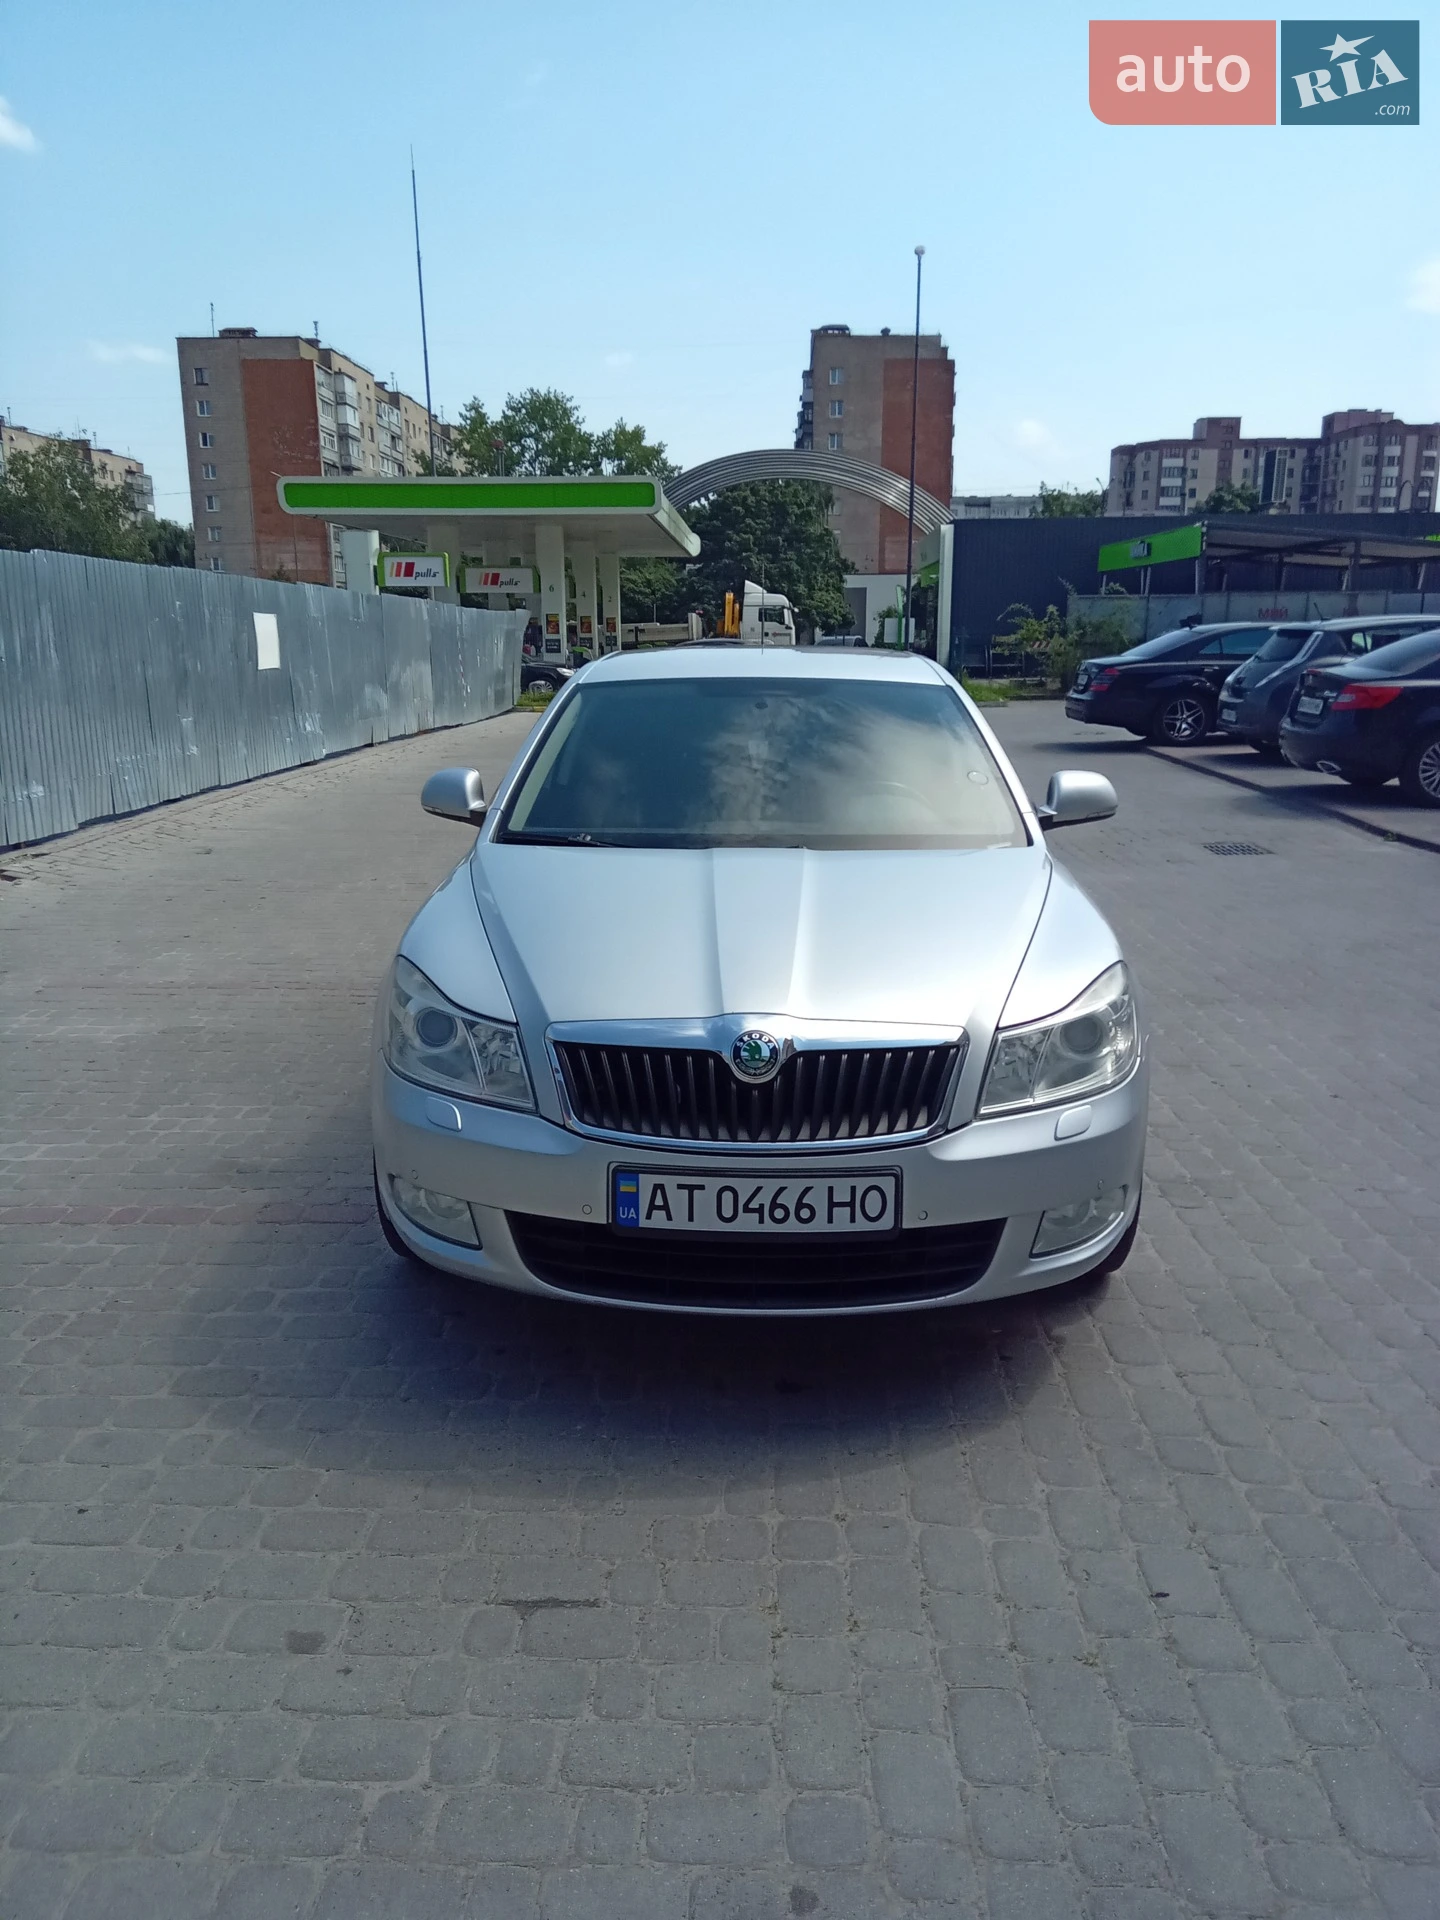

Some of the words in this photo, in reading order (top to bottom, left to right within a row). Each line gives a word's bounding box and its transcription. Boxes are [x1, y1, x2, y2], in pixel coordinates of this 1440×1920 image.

[414, 568, 439, 580] pulls
[499, 578, 521, 588] pulls
[548, 584, 555, 593] 6
[619, 1206, 638, 1219] UA
